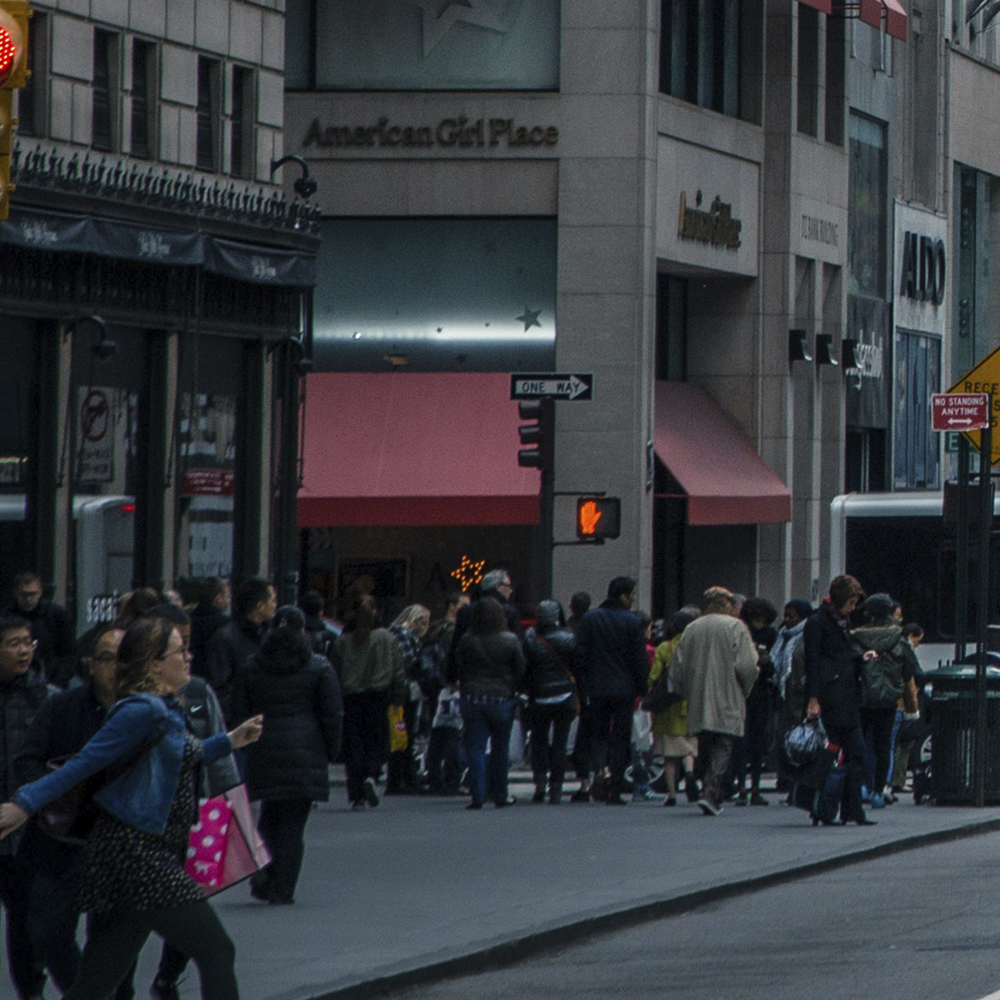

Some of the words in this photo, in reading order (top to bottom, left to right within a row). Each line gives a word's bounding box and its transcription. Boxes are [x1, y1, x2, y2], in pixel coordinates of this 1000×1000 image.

[303, 116, 434, 147] American
[437, 115, 485, 147] Girl
[489, 117, 559, 147] Place
[901, 231, 946, 305] ALDO
[522, 382, 546, 392] ONE
[556, 382, 580, 393] WAY
[935, 398, 946, 406] NO
[948, 396, 985, 406] STANDING
[941, 407, 979, 416] ANYTIME
